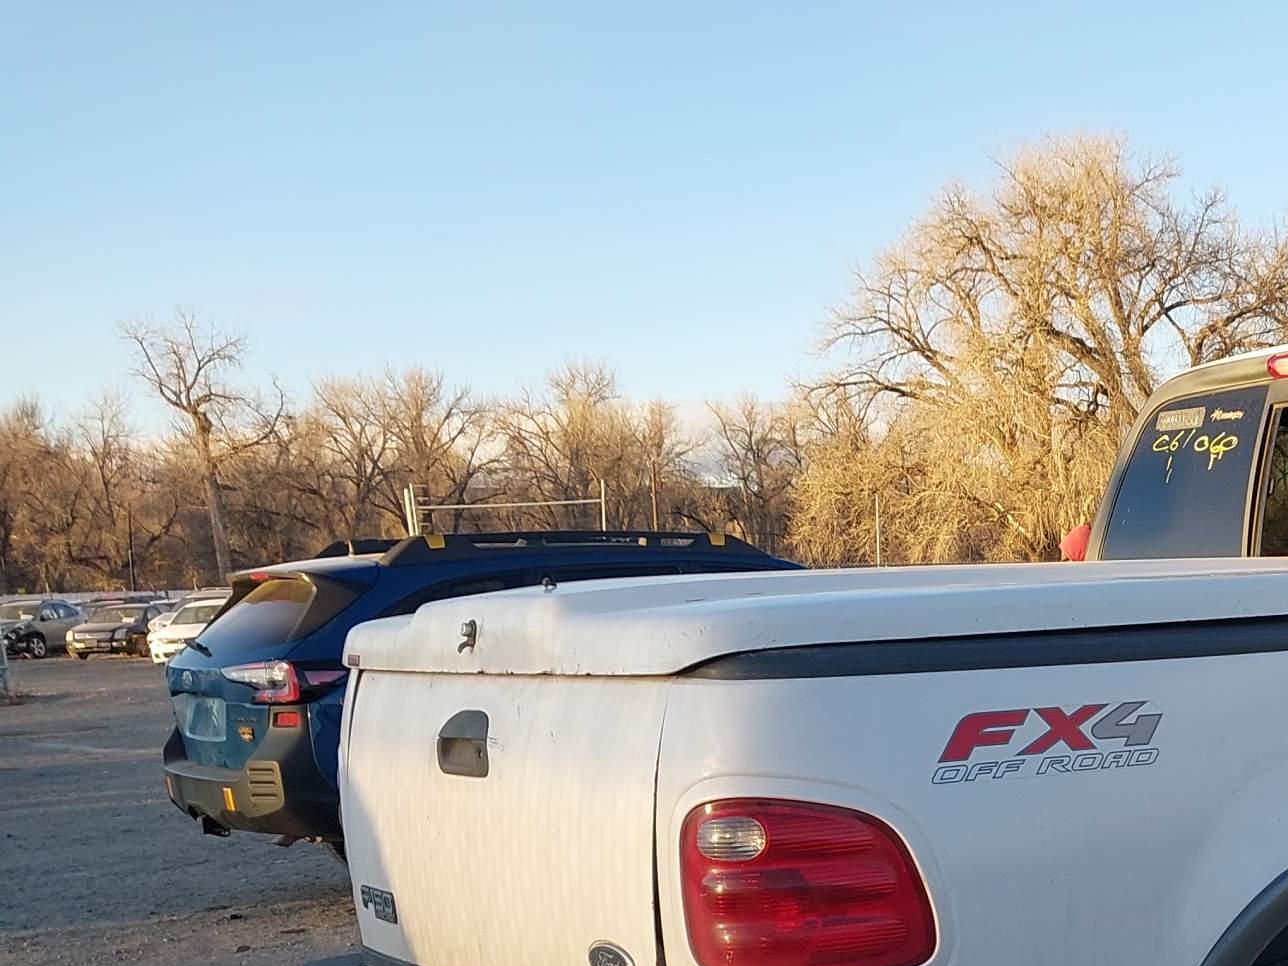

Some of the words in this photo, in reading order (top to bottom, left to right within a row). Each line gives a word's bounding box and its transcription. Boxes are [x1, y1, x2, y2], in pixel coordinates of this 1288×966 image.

[937, 700, 1163, 763] FX4
[931, 759, 1026, 785] OFF
[1036, 748, 1160, 775] ROAD
